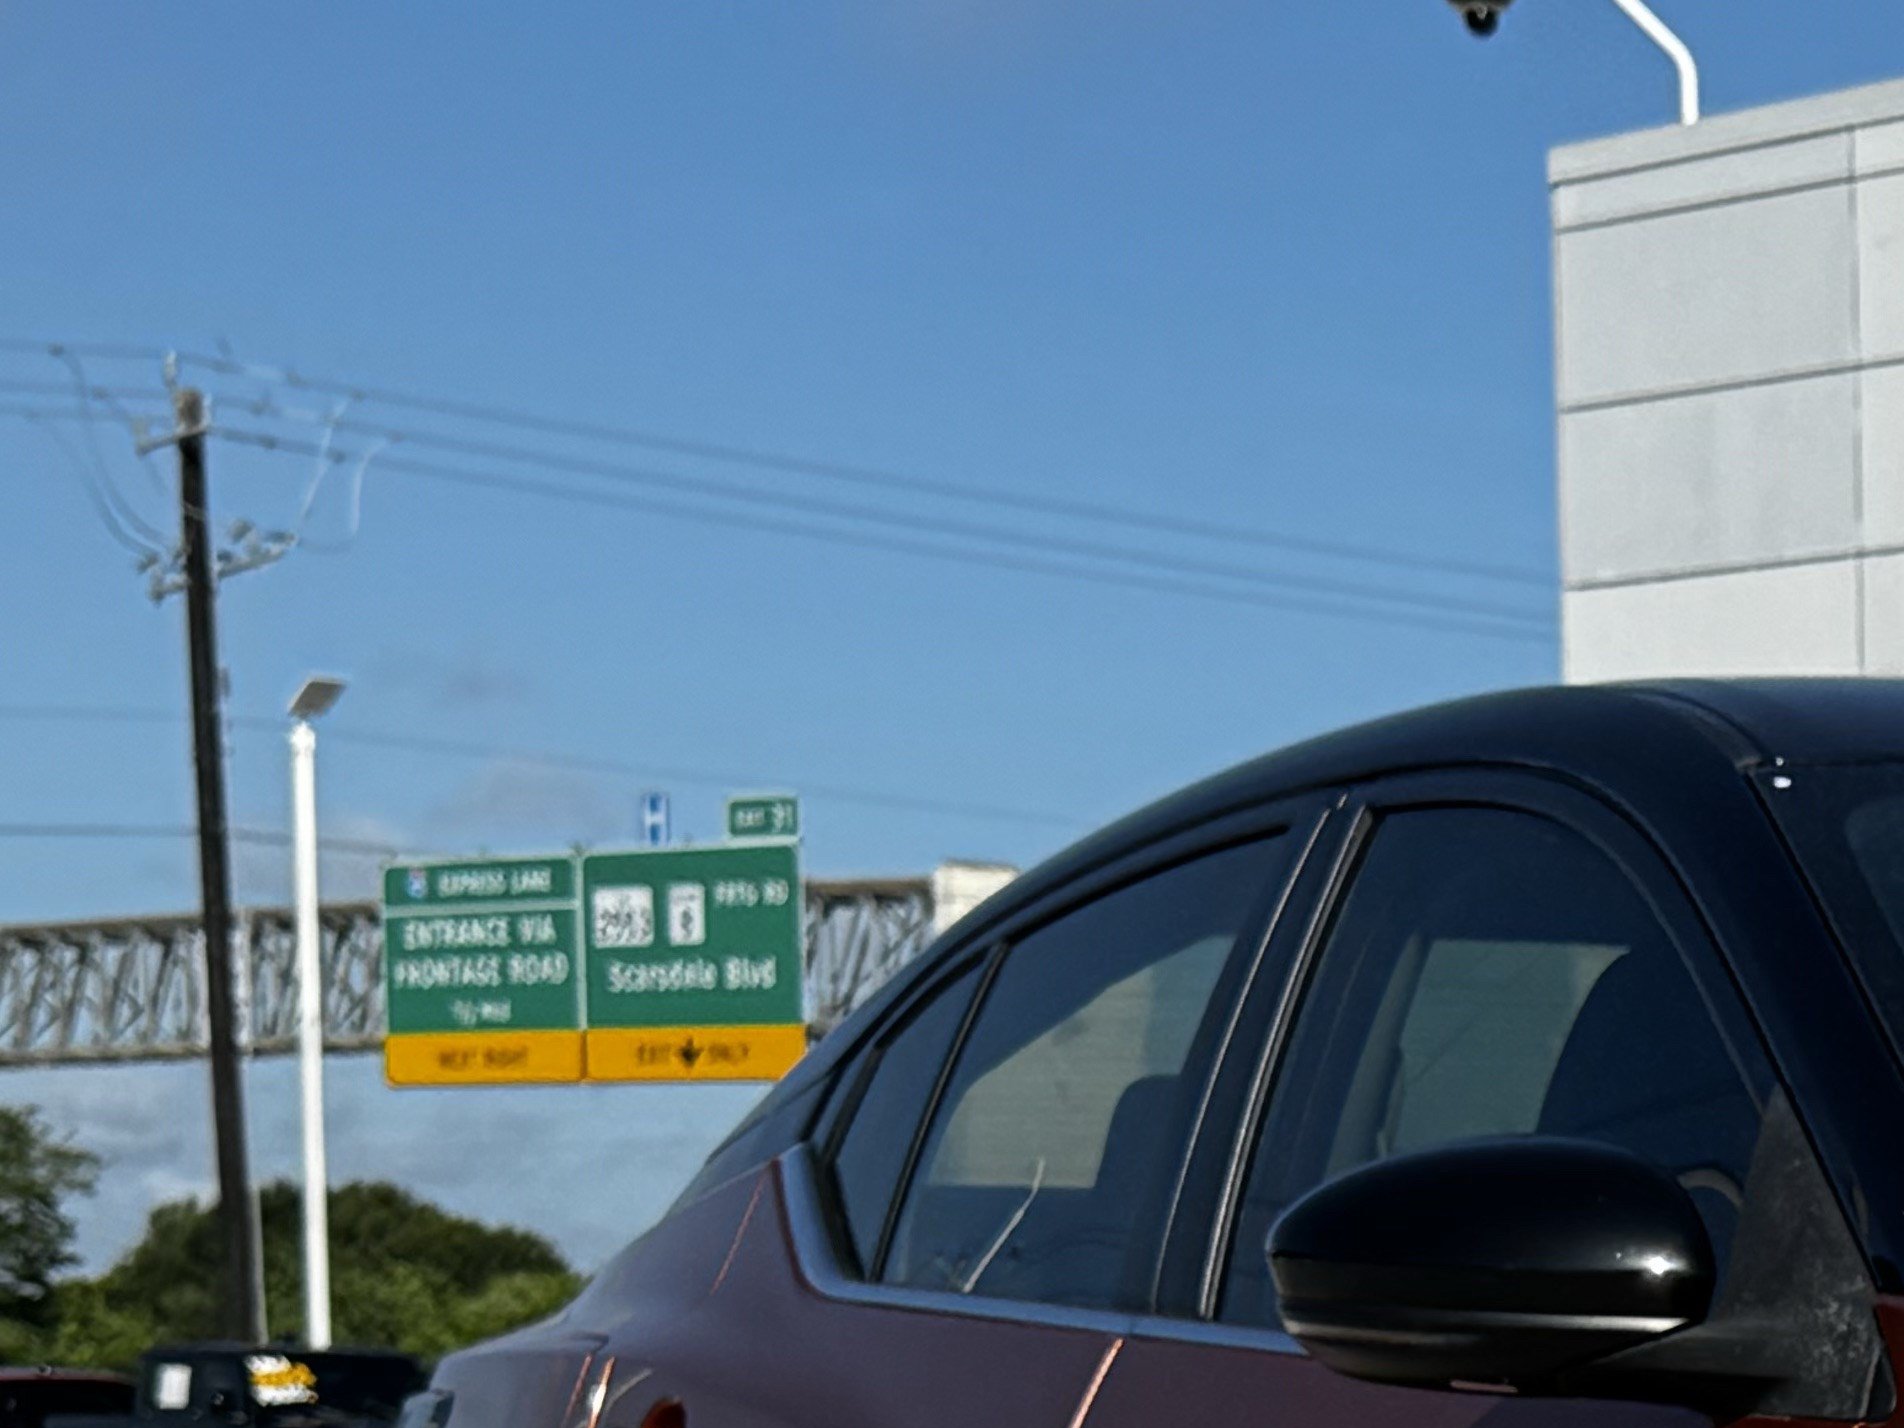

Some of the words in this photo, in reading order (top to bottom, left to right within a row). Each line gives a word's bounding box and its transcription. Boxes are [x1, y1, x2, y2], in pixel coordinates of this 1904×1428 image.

[437, 867, 507, 898] EXPRESS
[510, 866, 552, 895] LANE
[403, 915, 511, 950] ENTRANCE
[516, 913, 558, 945] VIA
[394, 953, 502, 990] FRONTAGE
[506, 951, 570, 985] ROAD
[608, 959, 719, 992] Scarsdale
[722, 955, 777, 990] Blvd
